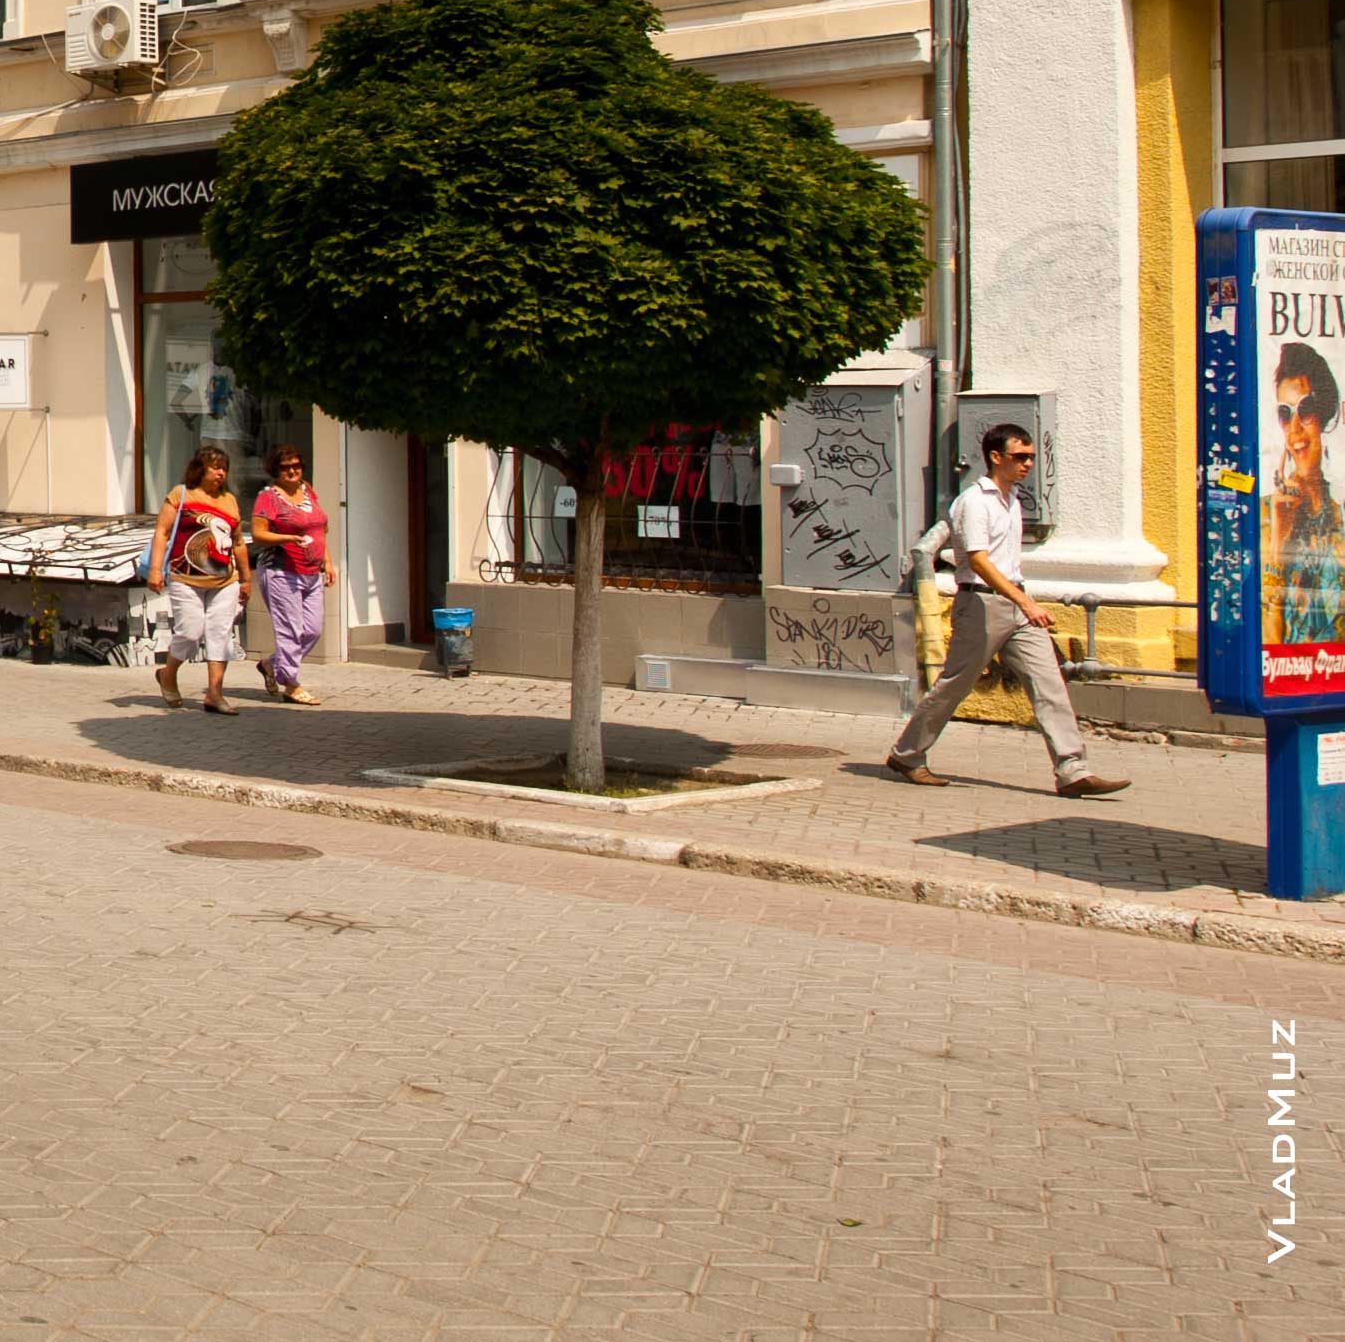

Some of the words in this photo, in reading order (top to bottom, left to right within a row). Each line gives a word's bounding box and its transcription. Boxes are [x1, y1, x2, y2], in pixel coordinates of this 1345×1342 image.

[1268, 236, 1329, 258] МАГАЗИН
[1272, 259, 1339, 282] ЖЕНСКОЙ
[1262, 650, 1313, 682] Бульвар
